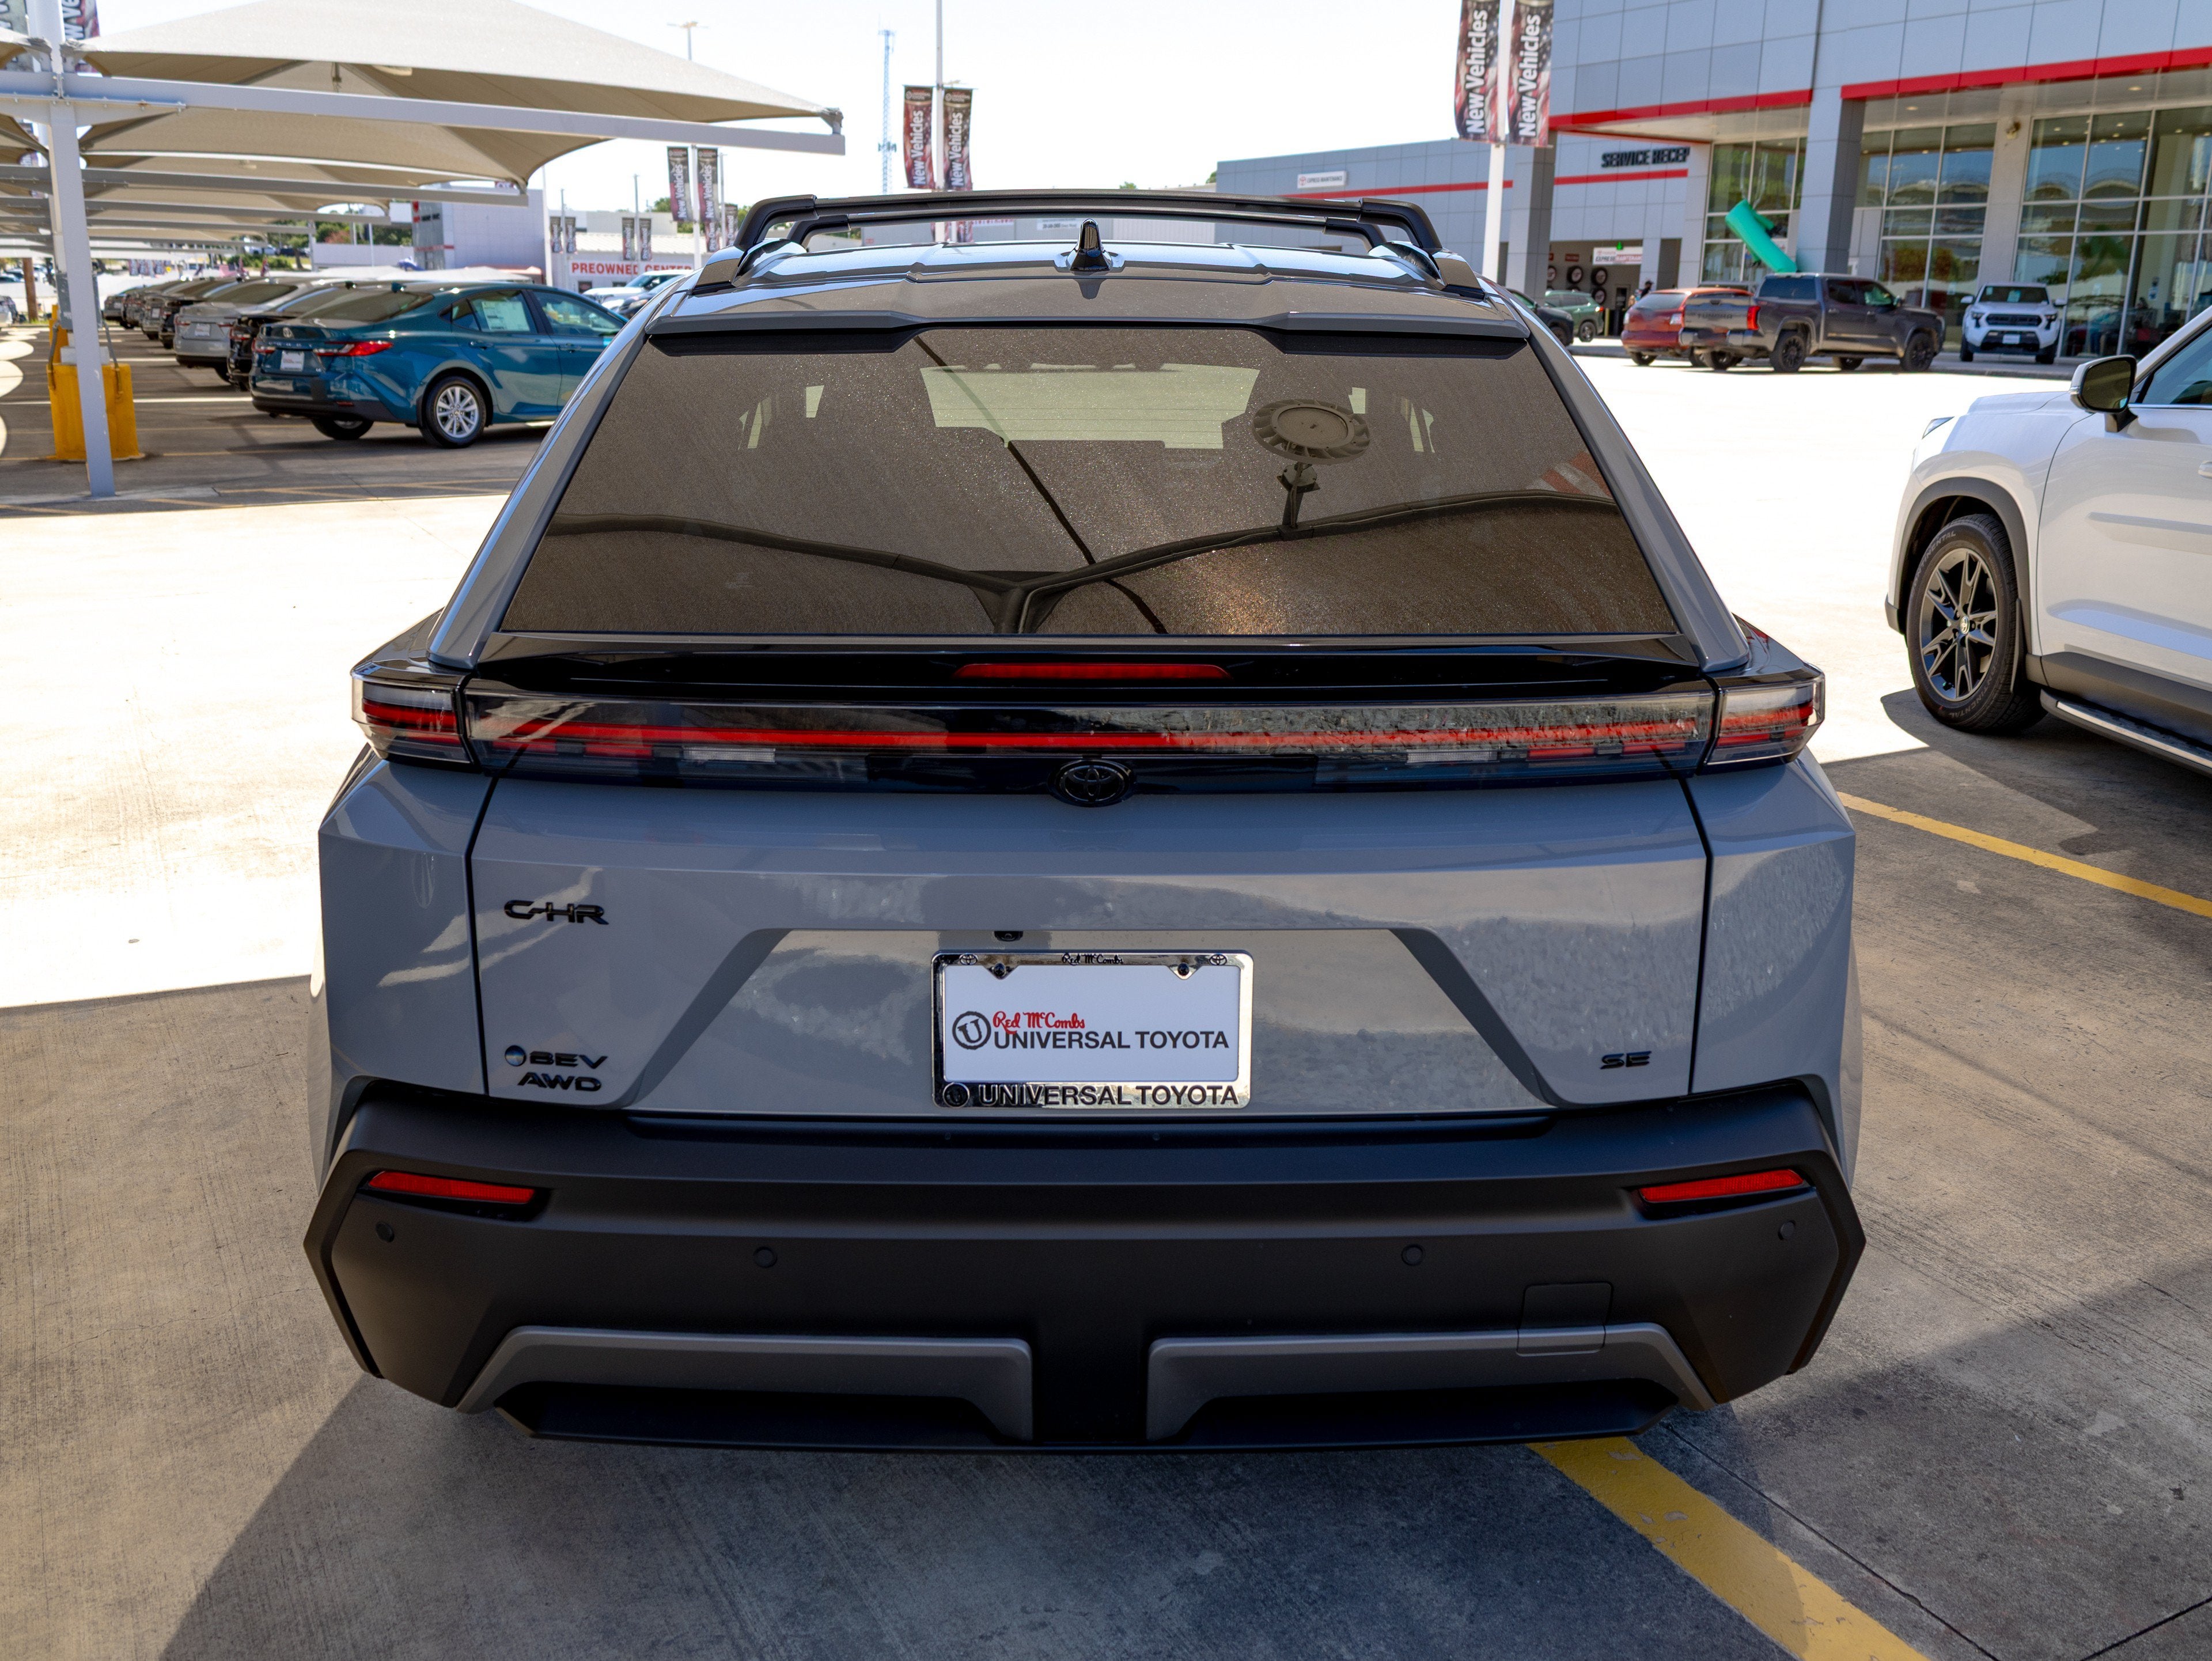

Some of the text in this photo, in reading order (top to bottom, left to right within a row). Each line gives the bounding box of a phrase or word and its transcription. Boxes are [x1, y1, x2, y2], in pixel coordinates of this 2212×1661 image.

[1465, 9, 1488, 134] New Vehicles
[1518, 14, 1541, 137] New Vehicles
[910, 110, 924, 159] Vehicles
[949, 112, 963, 160] Vehicles
[1601, 149, 1651, 168] SERVICE
[673, 164, 685, 199] Vehicles
[702, 165, 713, 199] Vehicles
[912, 160, 926, 186] New
[951, 162, 964, 187] New
[677, 200, 687, 218] New
[705, 200, 714, 218] New
[504, 899, 609, 925] C-HR
[1062, 953, 1123, 966] Red McCombs
[993, 1011, 1085, 1034] Red McCombs
[994, 1031, 1229, 1049] UNIVERSAL TOYOTA
[529, 1051, 608, 1069] BEV
[1599, 1050, 1652, 1070] SE
[517, 1072, 602, 1092] AWD
[979, 1084, 1238, 1105] UNIVERSAL TOYOTA
